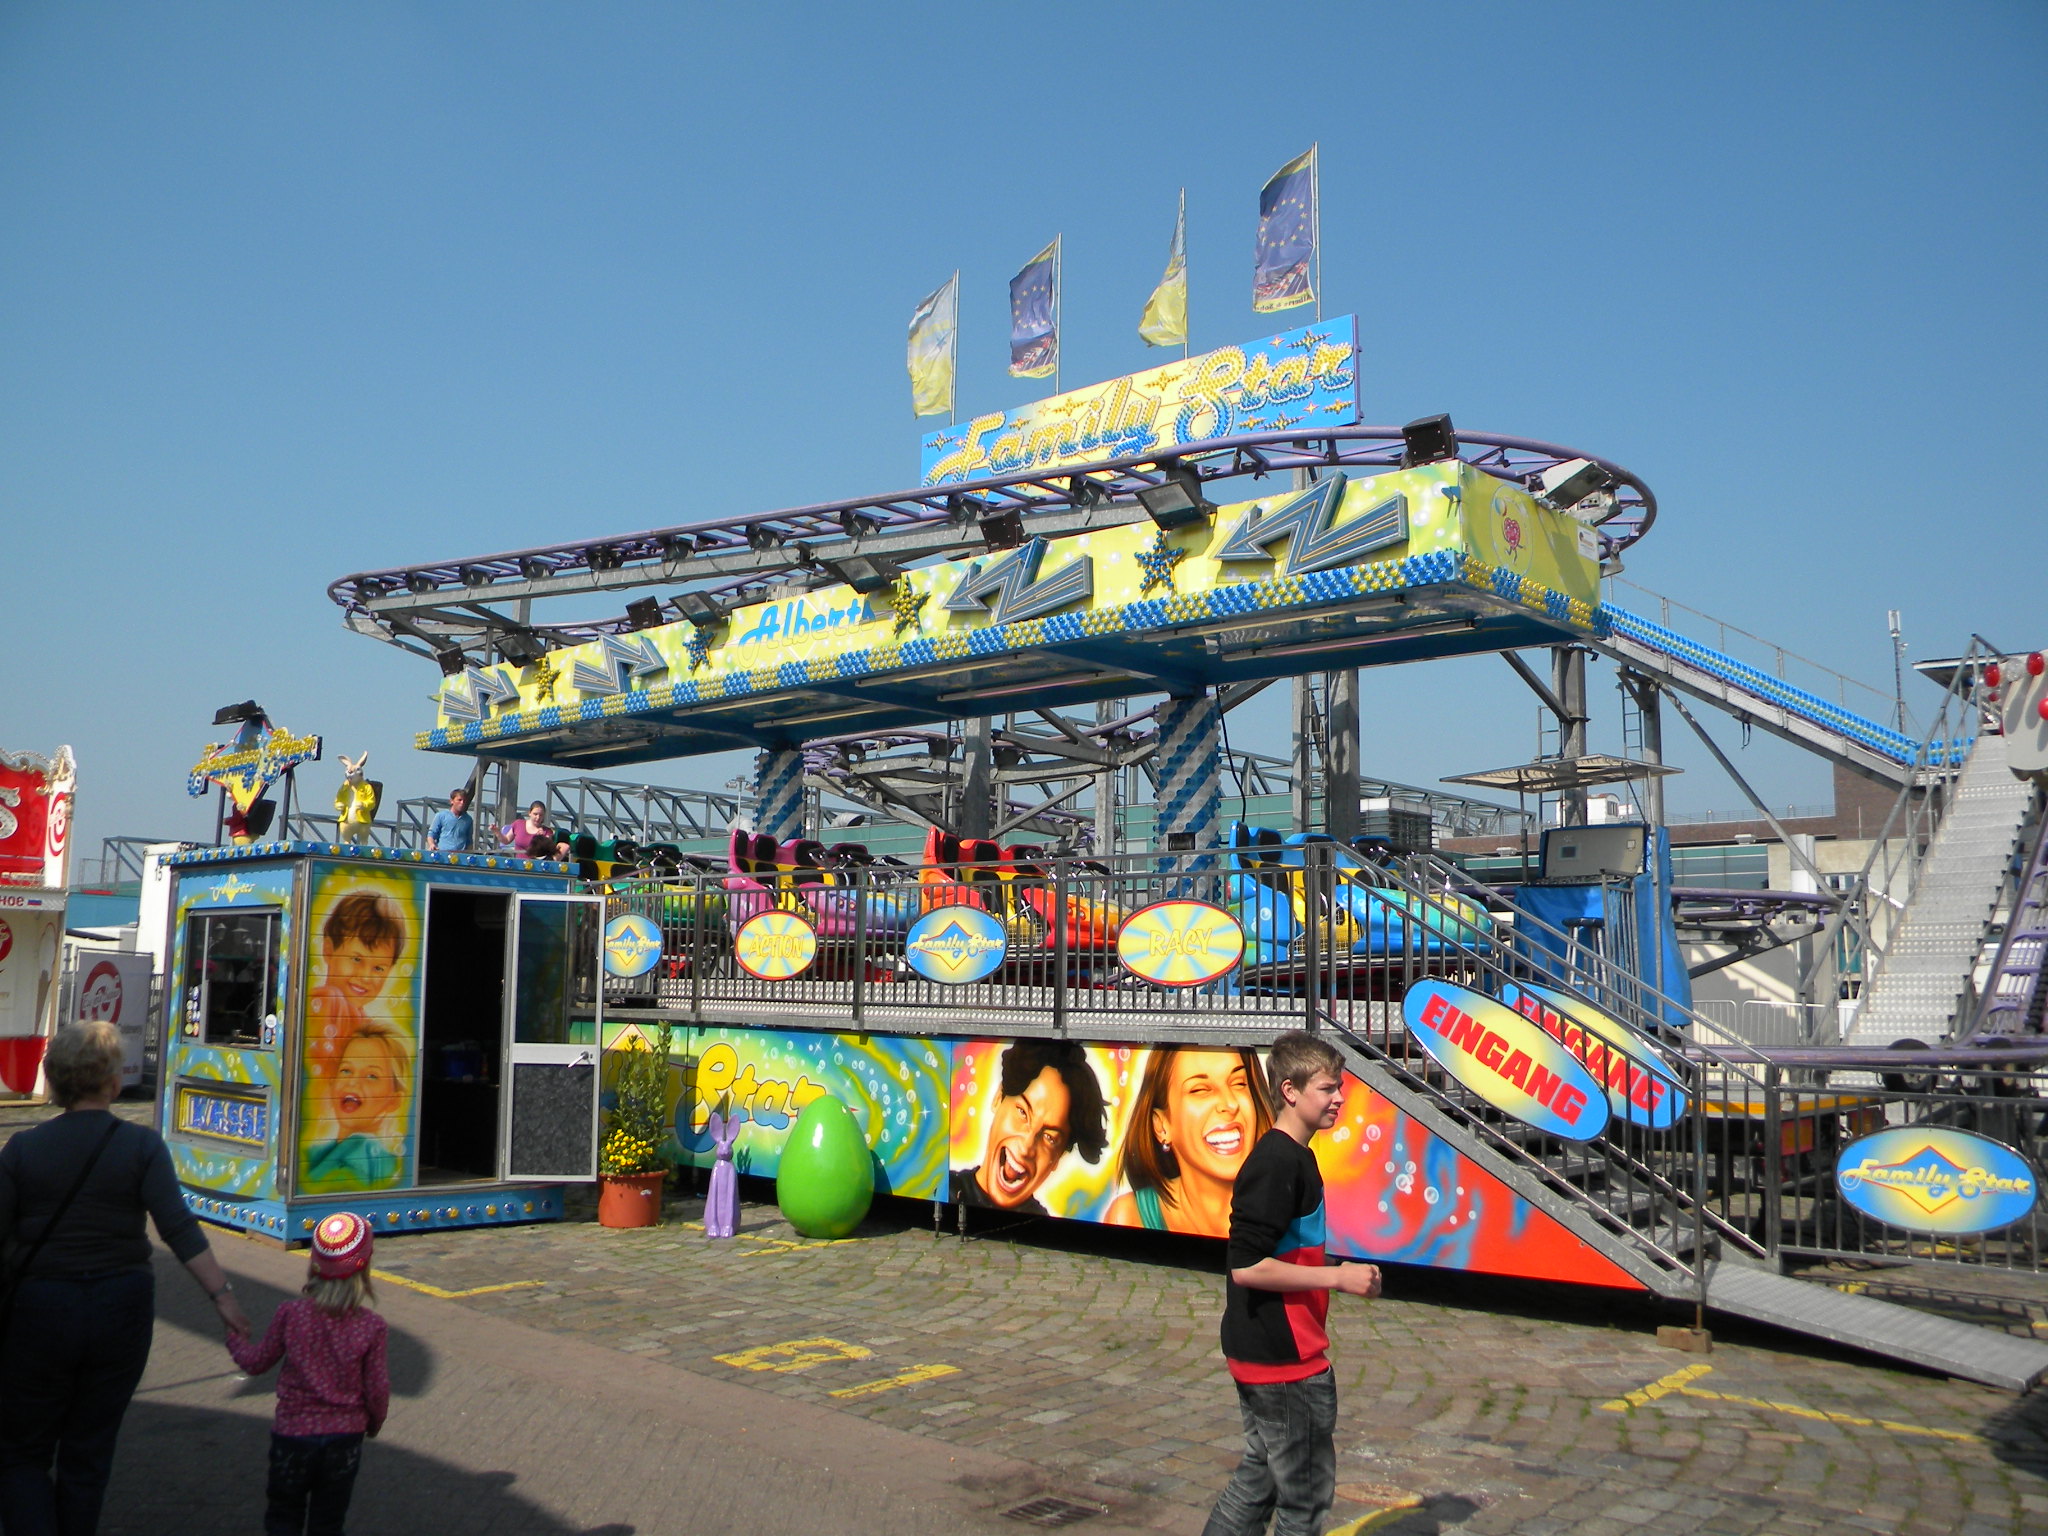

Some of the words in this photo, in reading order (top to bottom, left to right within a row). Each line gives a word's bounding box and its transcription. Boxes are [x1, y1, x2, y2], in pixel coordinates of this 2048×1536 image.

[921, 375, 1161, 507] Family
[1173, 344, 1355, 450] Star
[748, 933, 804, 959] ACTION
[907, 933, 967, 959] Family
[966, 933, 1004, 958] Star
[1148, 927, 1213, 957] RACY
[1419, 993, 1588, 1126] EINGANG
[1838, 1158, 1951, 1199] Family
[1957, 1166, 2032, 1200] Star
